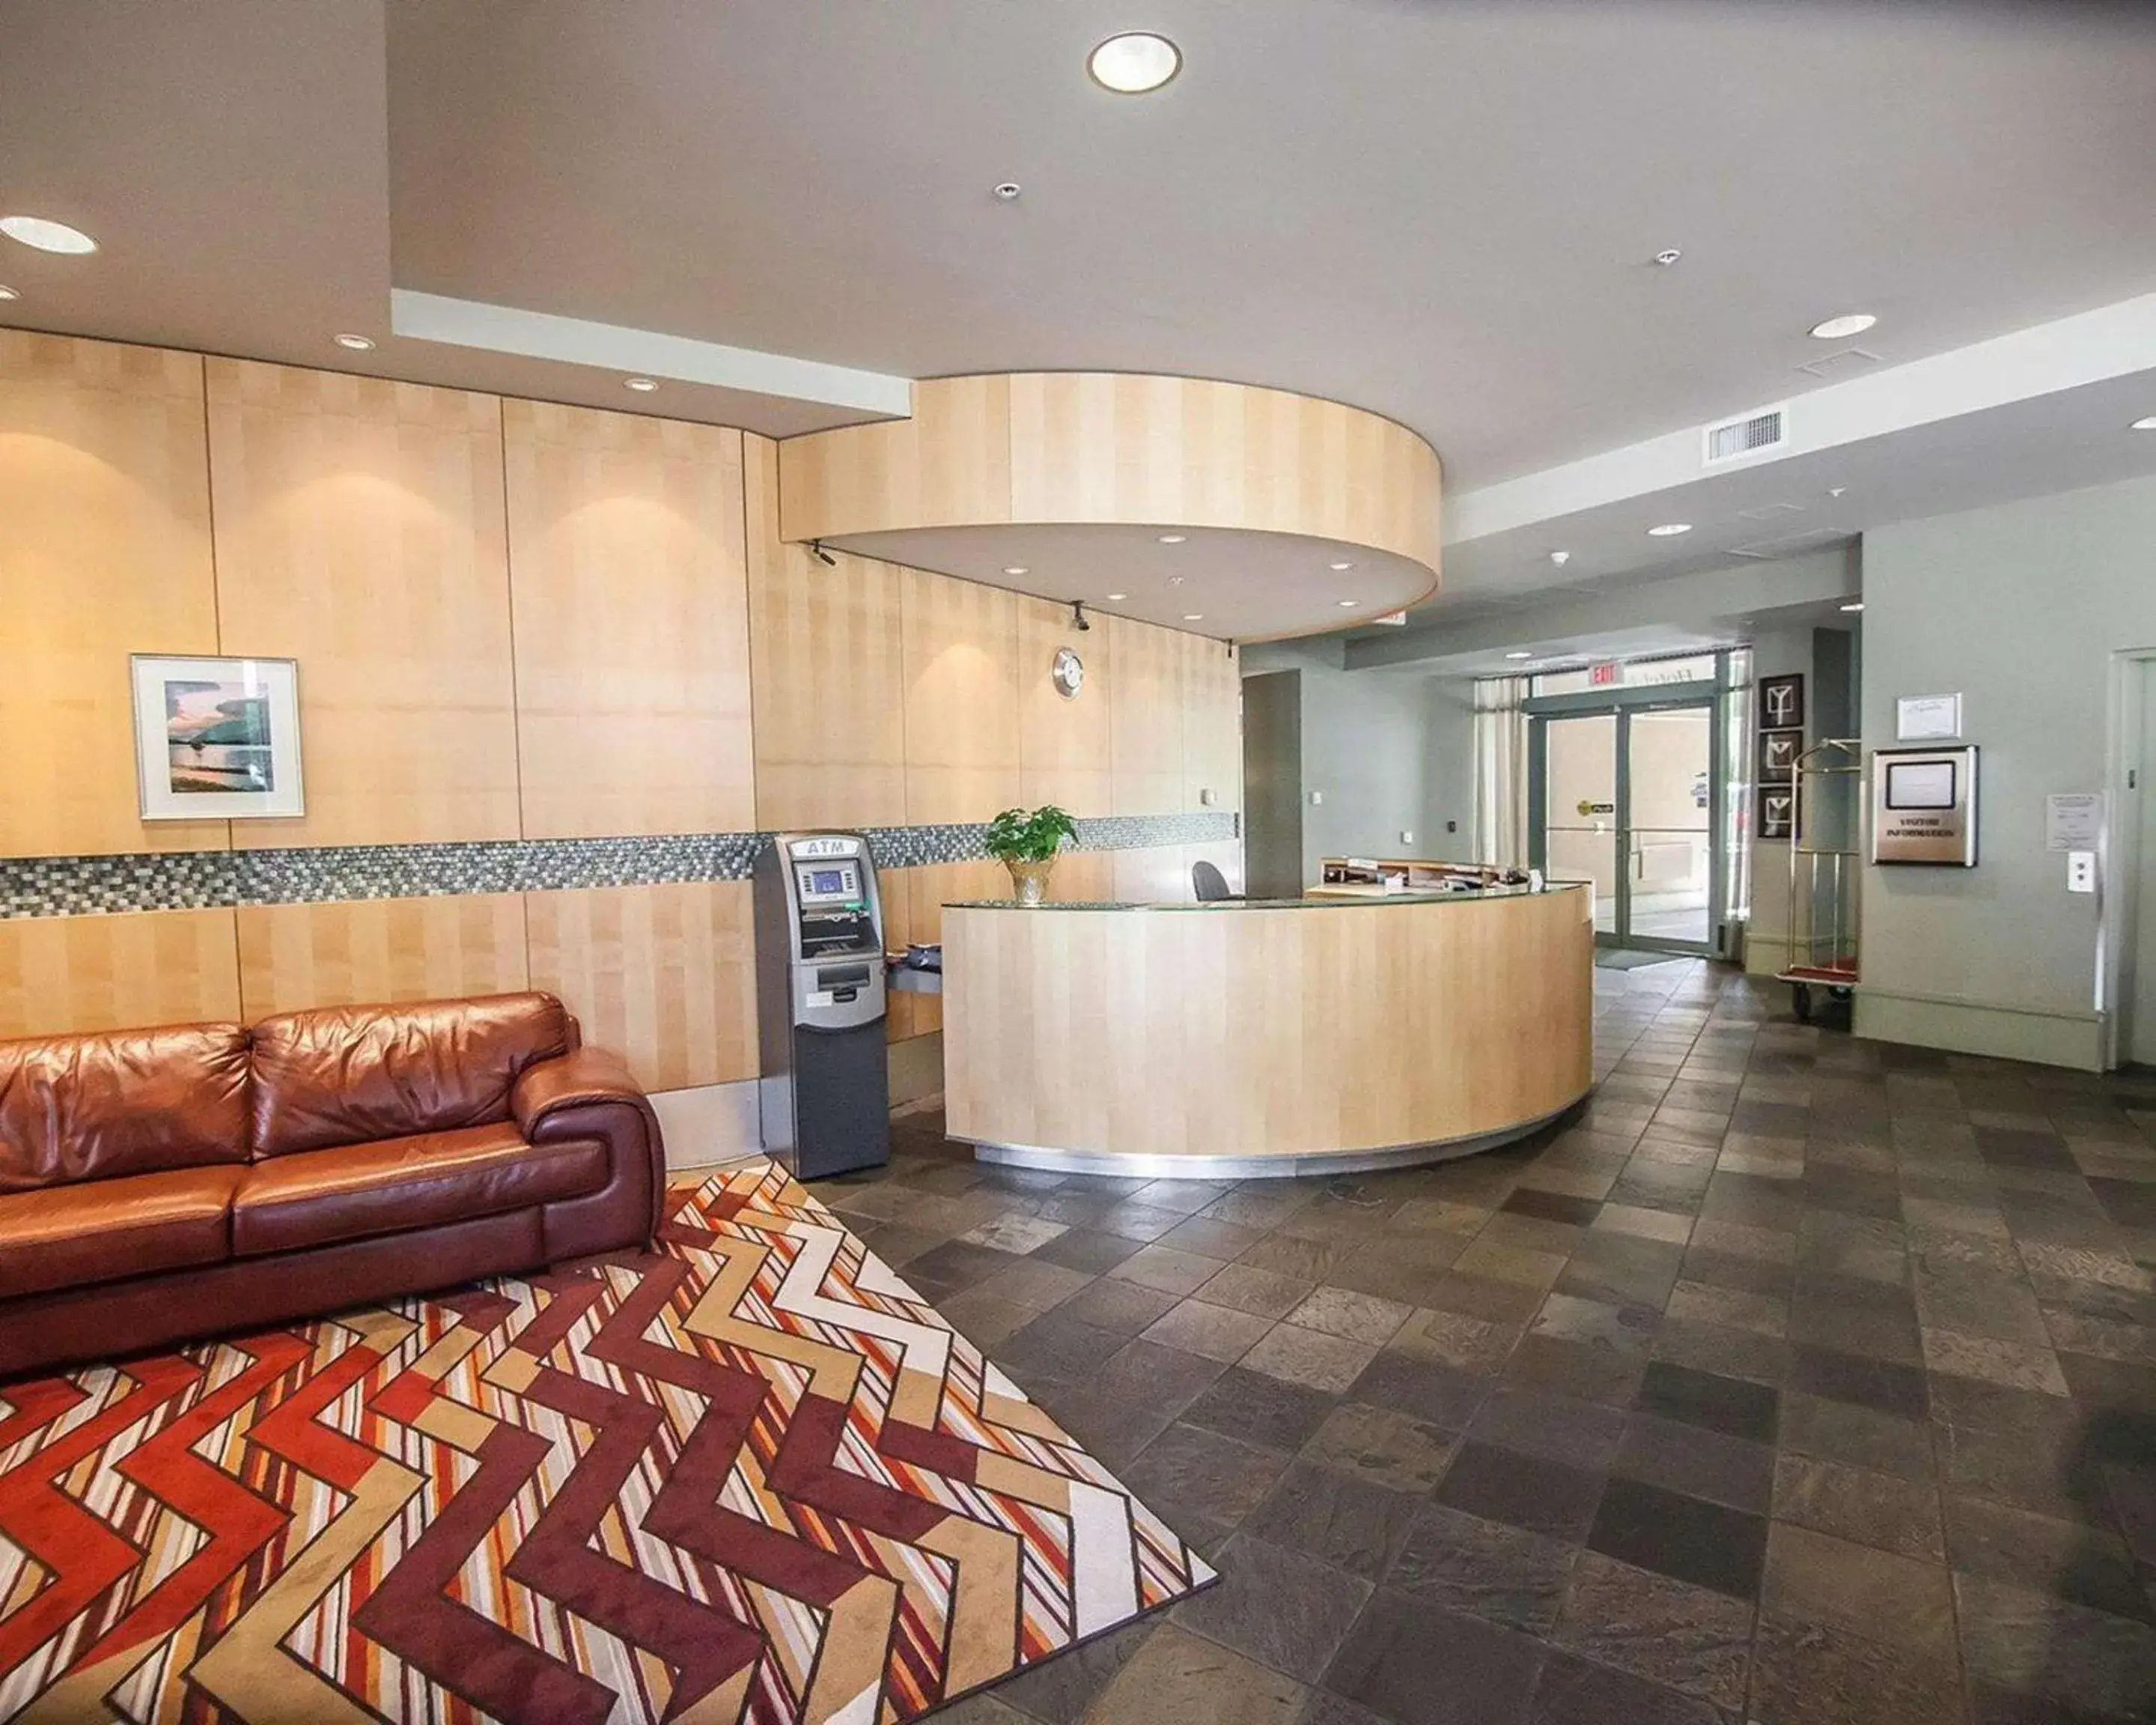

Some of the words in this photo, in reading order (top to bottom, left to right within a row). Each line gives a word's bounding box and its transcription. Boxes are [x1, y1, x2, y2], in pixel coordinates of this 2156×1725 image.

[1595, 665, 1615, 684] EXIT
[1886, 829, 1955, 837] INFORMATION
[808, 841, 844, 854] ATM
